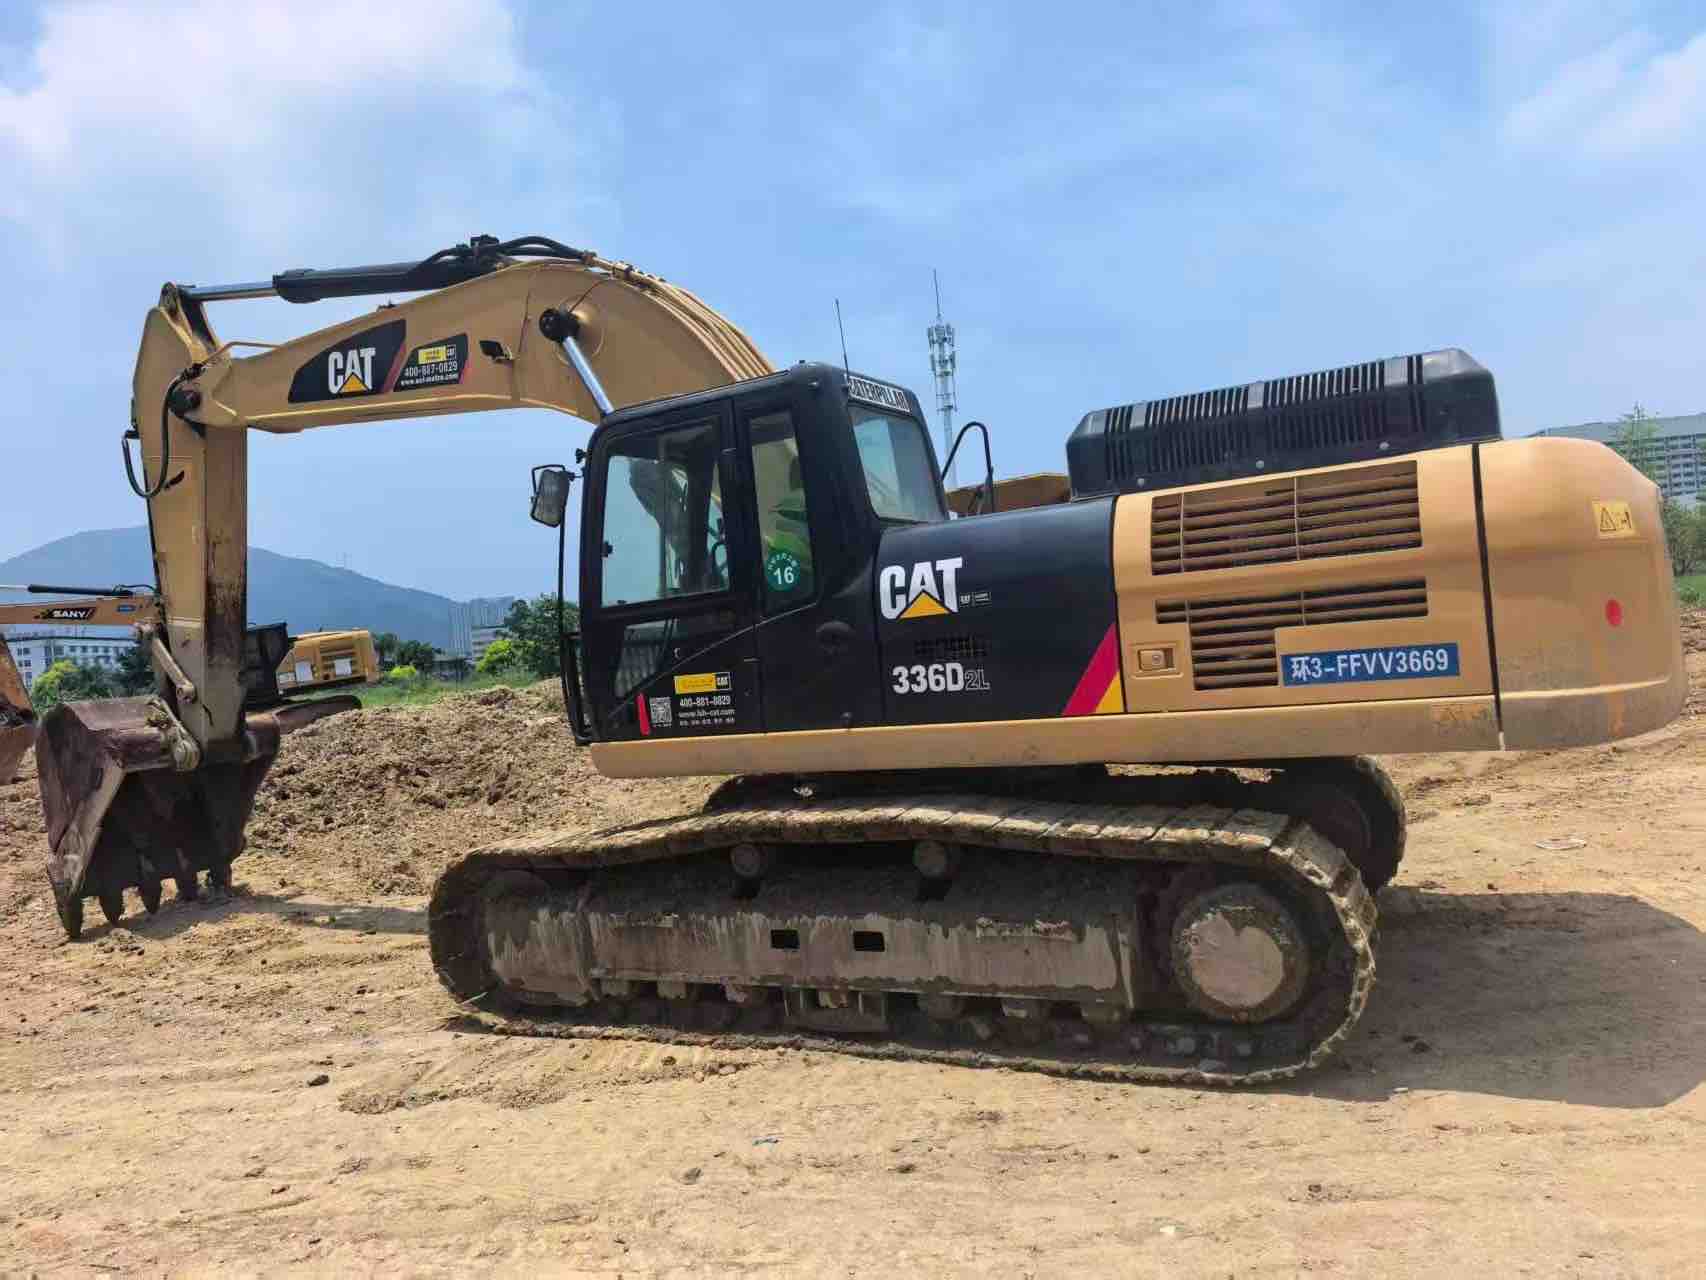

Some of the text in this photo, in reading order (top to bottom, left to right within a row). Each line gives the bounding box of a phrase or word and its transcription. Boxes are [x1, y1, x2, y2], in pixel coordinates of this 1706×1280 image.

[328, 346, 376, 394] CAT
[848, 378, 911, 412] CATERPILLAR
[773, 566, 795, 585] 16
[880, 556, 963, 619] CAT
[52, 609, 87, 619] SANY
[1290, 648, 1449, 682] 环3-FFVV3669
